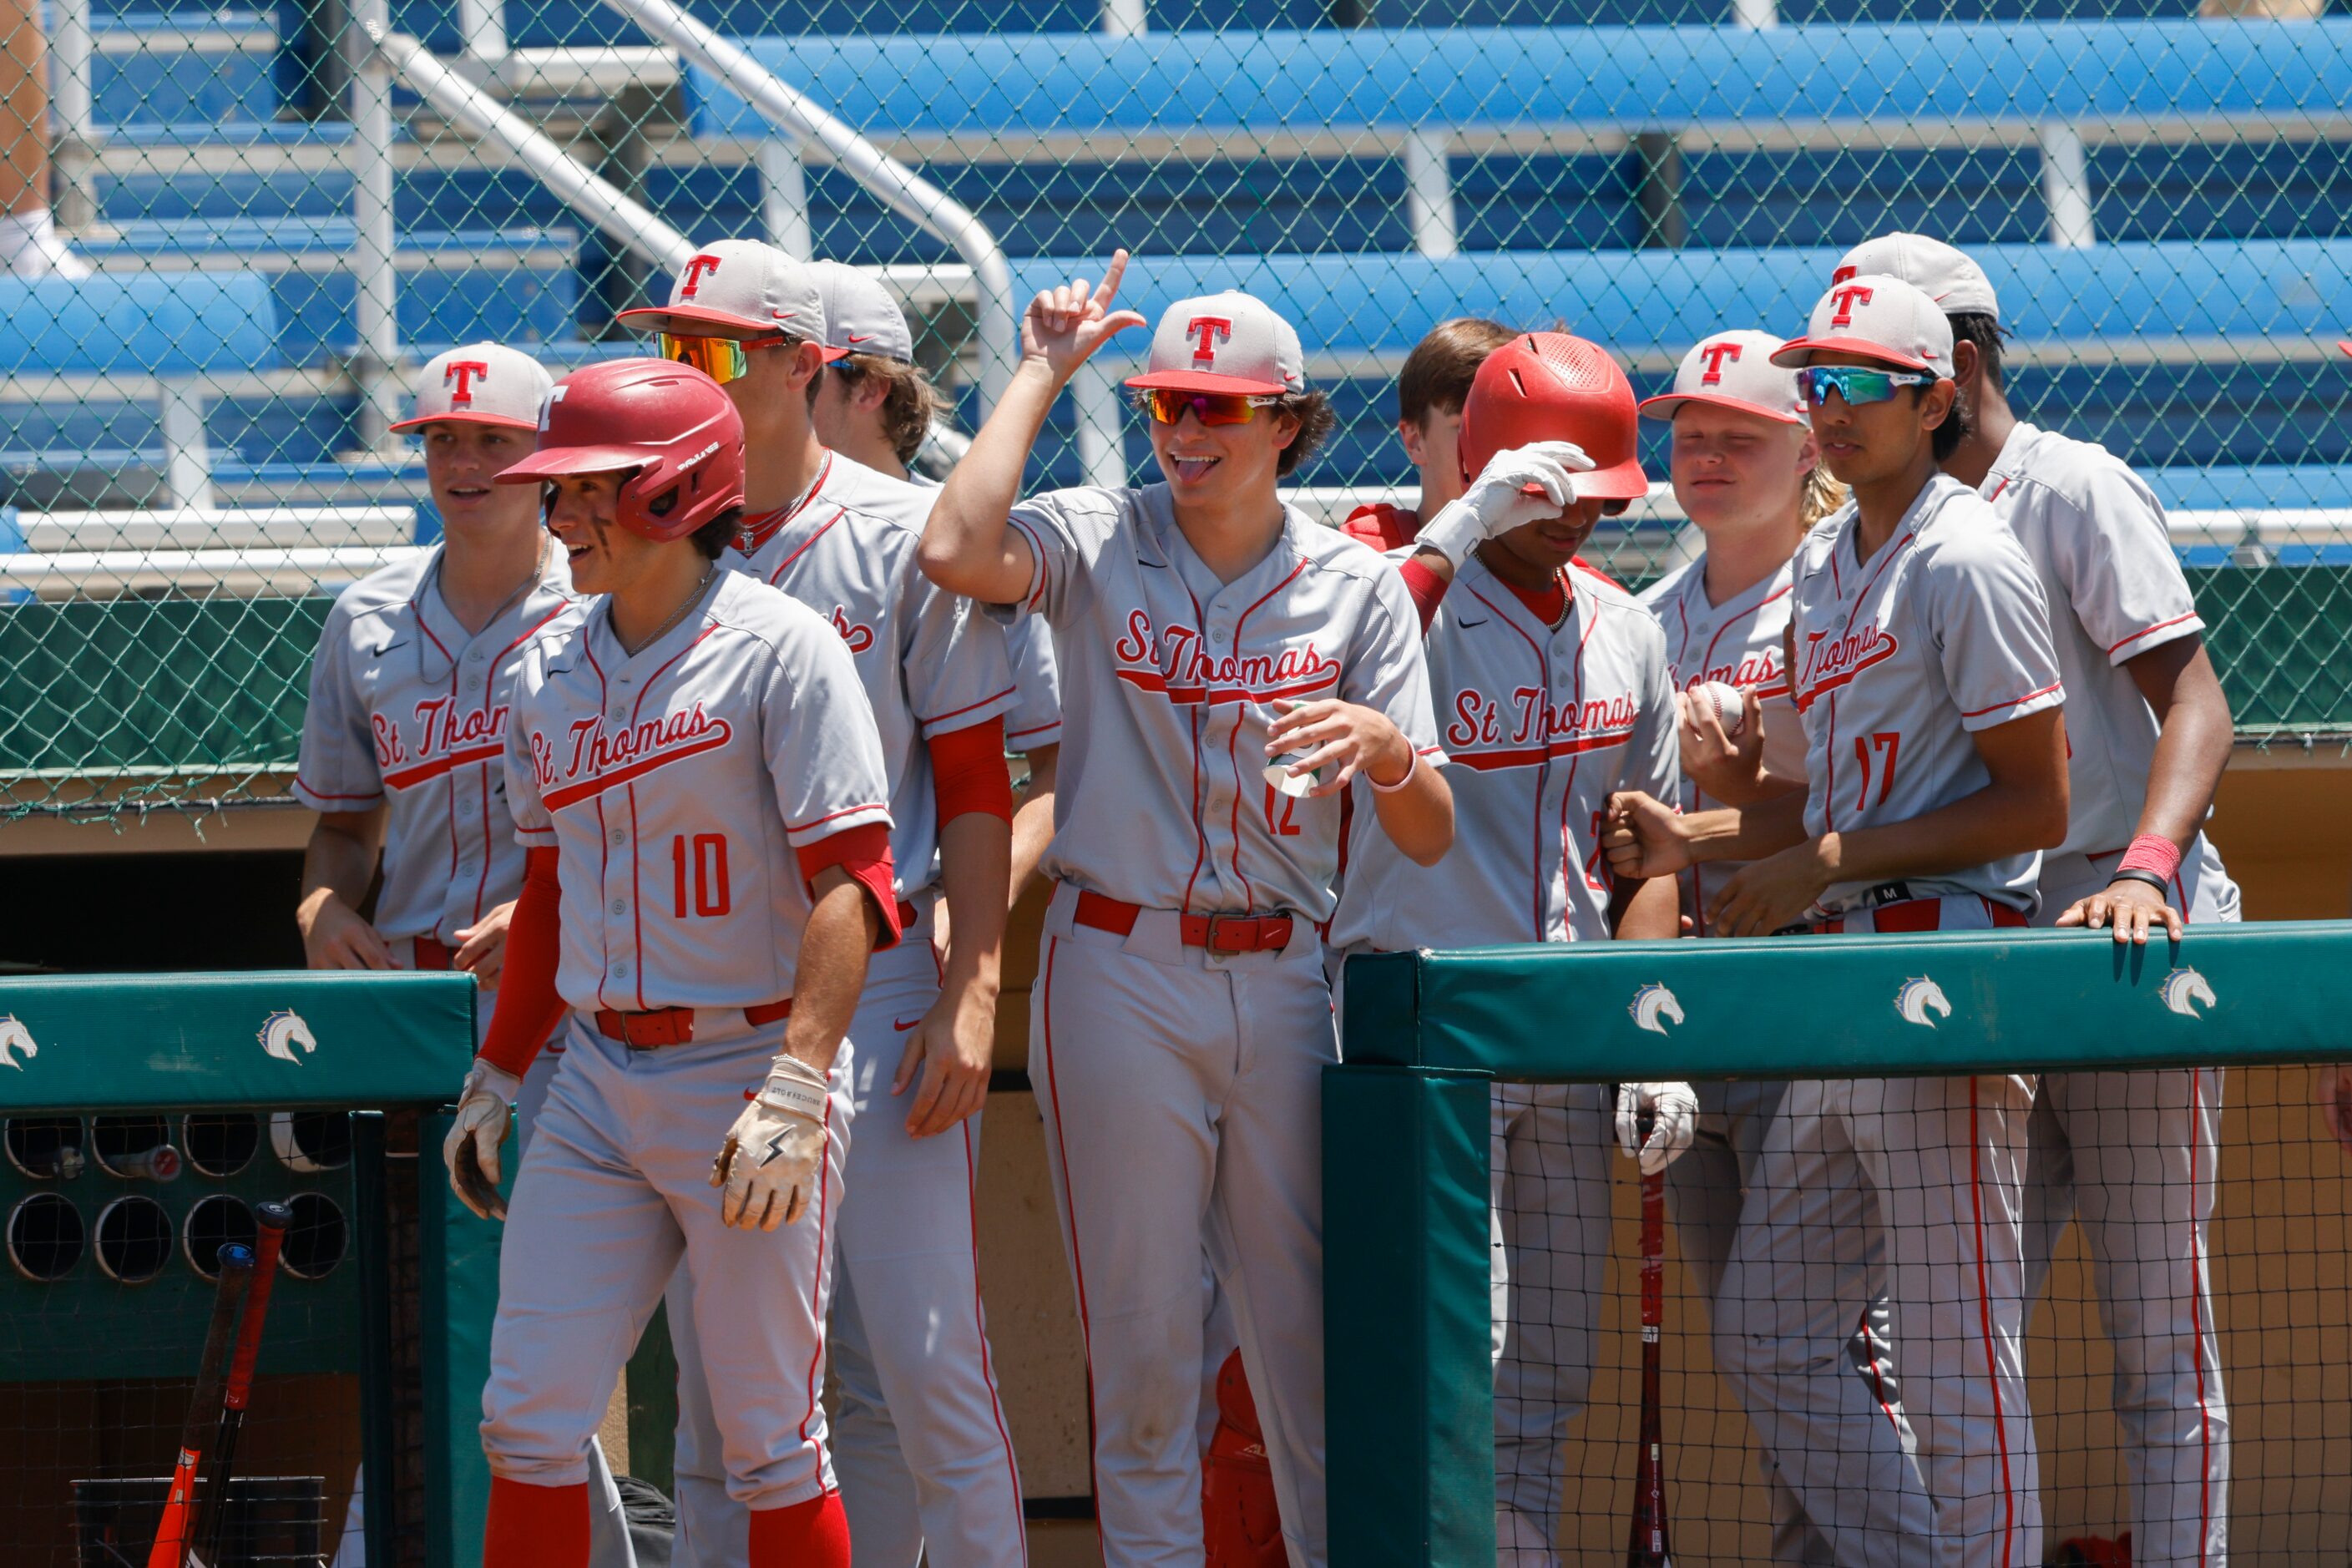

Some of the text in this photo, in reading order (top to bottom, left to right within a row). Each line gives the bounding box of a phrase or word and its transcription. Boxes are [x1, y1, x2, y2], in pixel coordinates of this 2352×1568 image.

[681, 254, 722, 296] T
[1829, 285, 1874, 327] T
[1187, 315, 1233, 362] T
[1701, 342, 1743, 385] T
[445, 361, 488, 402] T
[1163, 623, 1322, 685] Thomas
[372, 693, 508, 768] St. Thom
[566, 700, 713, 777] Thomas
[1447, 684, 1638, 748] St. Thomas
[1854, 732, 1900, 812] 17
[673, 833, 731, 918] 10
[1883, 888, 1898, 899] M
